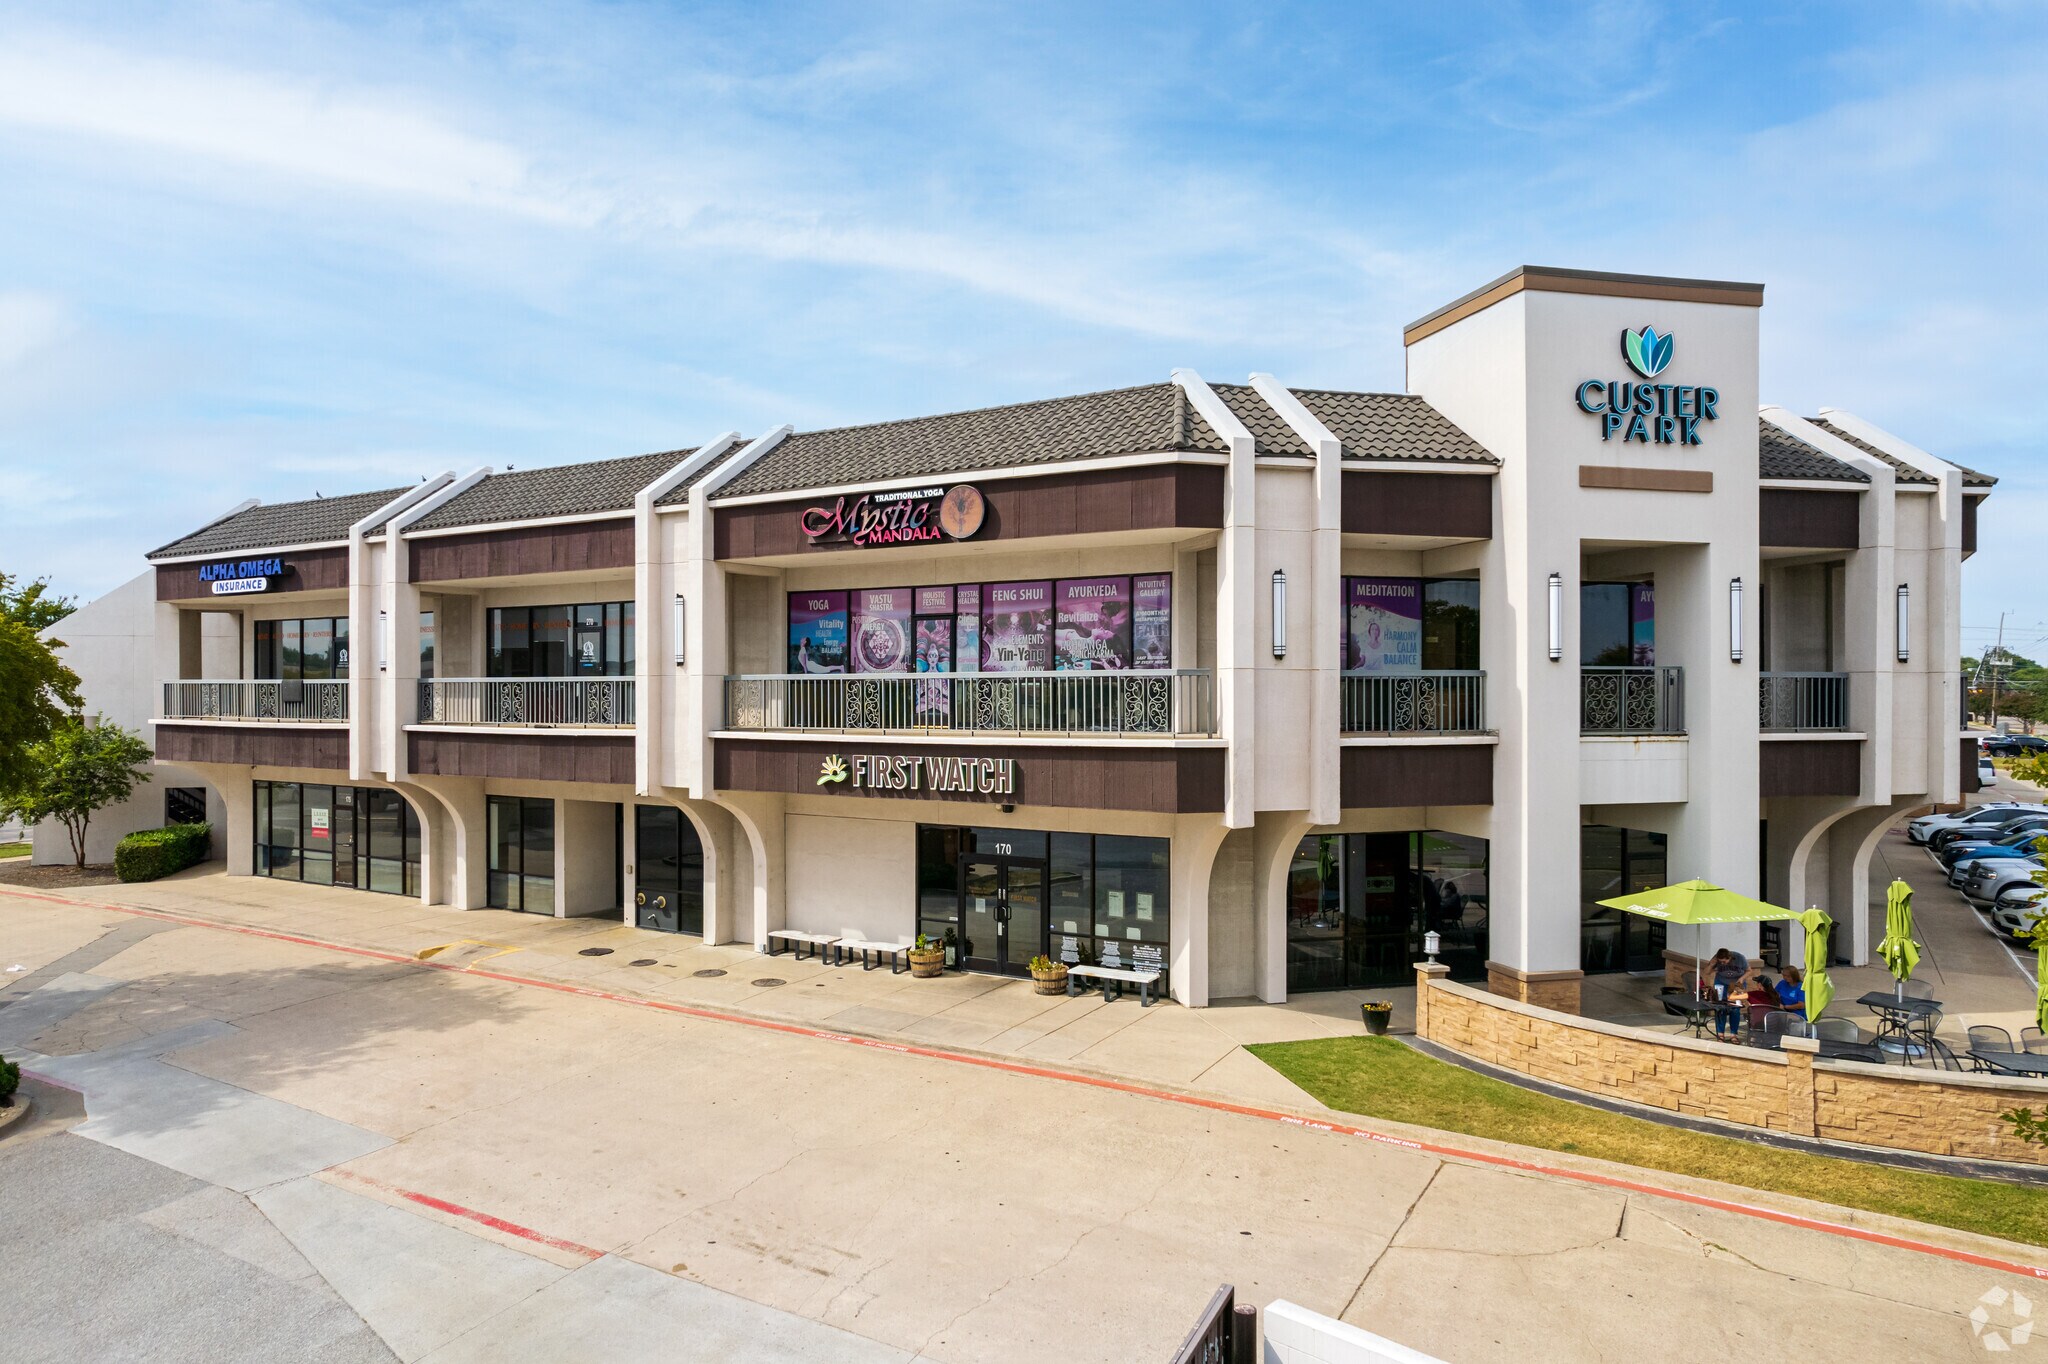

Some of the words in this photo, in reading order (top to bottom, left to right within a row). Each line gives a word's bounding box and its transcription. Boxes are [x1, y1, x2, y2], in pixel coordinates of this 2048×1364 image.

[1576, 378, 1720, 420] CUSTER
[1602, 412, 1703, 445] PARK
[875, 491, 922, 502] TRADITIONAL
[923, 488, 944, 498] YOGA
[802, 495, 930, 545] Mystic
[869, 526, 940, 543] MANDALA
[199, 563, 236, 581] ALPHA
[238, 558, 281, 578] OMEGA
[215, 579, 263, 592] INSURANCE
[1137, 580, 1166, 589] INTUITIVE
[1356, 584, 1415, 597] MEDITATION
[922, 590, 946, 599] HOLISTIC
[957, 590, 979, 598] CRYSTAL
[992, 589, 1017, 602] FENG
[1019, 588, 1043, 600] SHUI
[1068, 584, 1118, 598] AYURVEDA
[1139, 589, 1165, 597] GALLERY
[808, 599, 829, 611] YOGA
[869, 594, 893, 604] VASTU
[922, 598, 946, 606] FESTIVAL
[957, 597, 979, 605] HEALING
[869, 603, 893, 611] SHASTRA
[1058, 612, 1099, 622] Revitalize
[819, 619, 844, 630] Vitality
[1134, 623, 1169, 637] FAIR
[815, 630, 832, 638] HEALTH
[1011, 634, 1045, 645] ELEMENTS
[1383, 630, 1417, 641] HARMONY
[823, 638, 839, 646] Energy
[1396, 642, 1417, 653] CALM
[997, 647, 1045, 664] Yin-Yang
[1383, 653, 1417, 665] BALANCE
[852, 755, 923, 790] FIRST
[925, 756, 1015, 794] WATCH
[995, 843, 1012, 855] 170
[1280, 1115, 1304, 1126] FIRE
[1304, 1120, 1333, 1131] LANE
[1353, 1131, 1371, 1139] NO
[1372, 1134, 1422, 1149] PARKING
